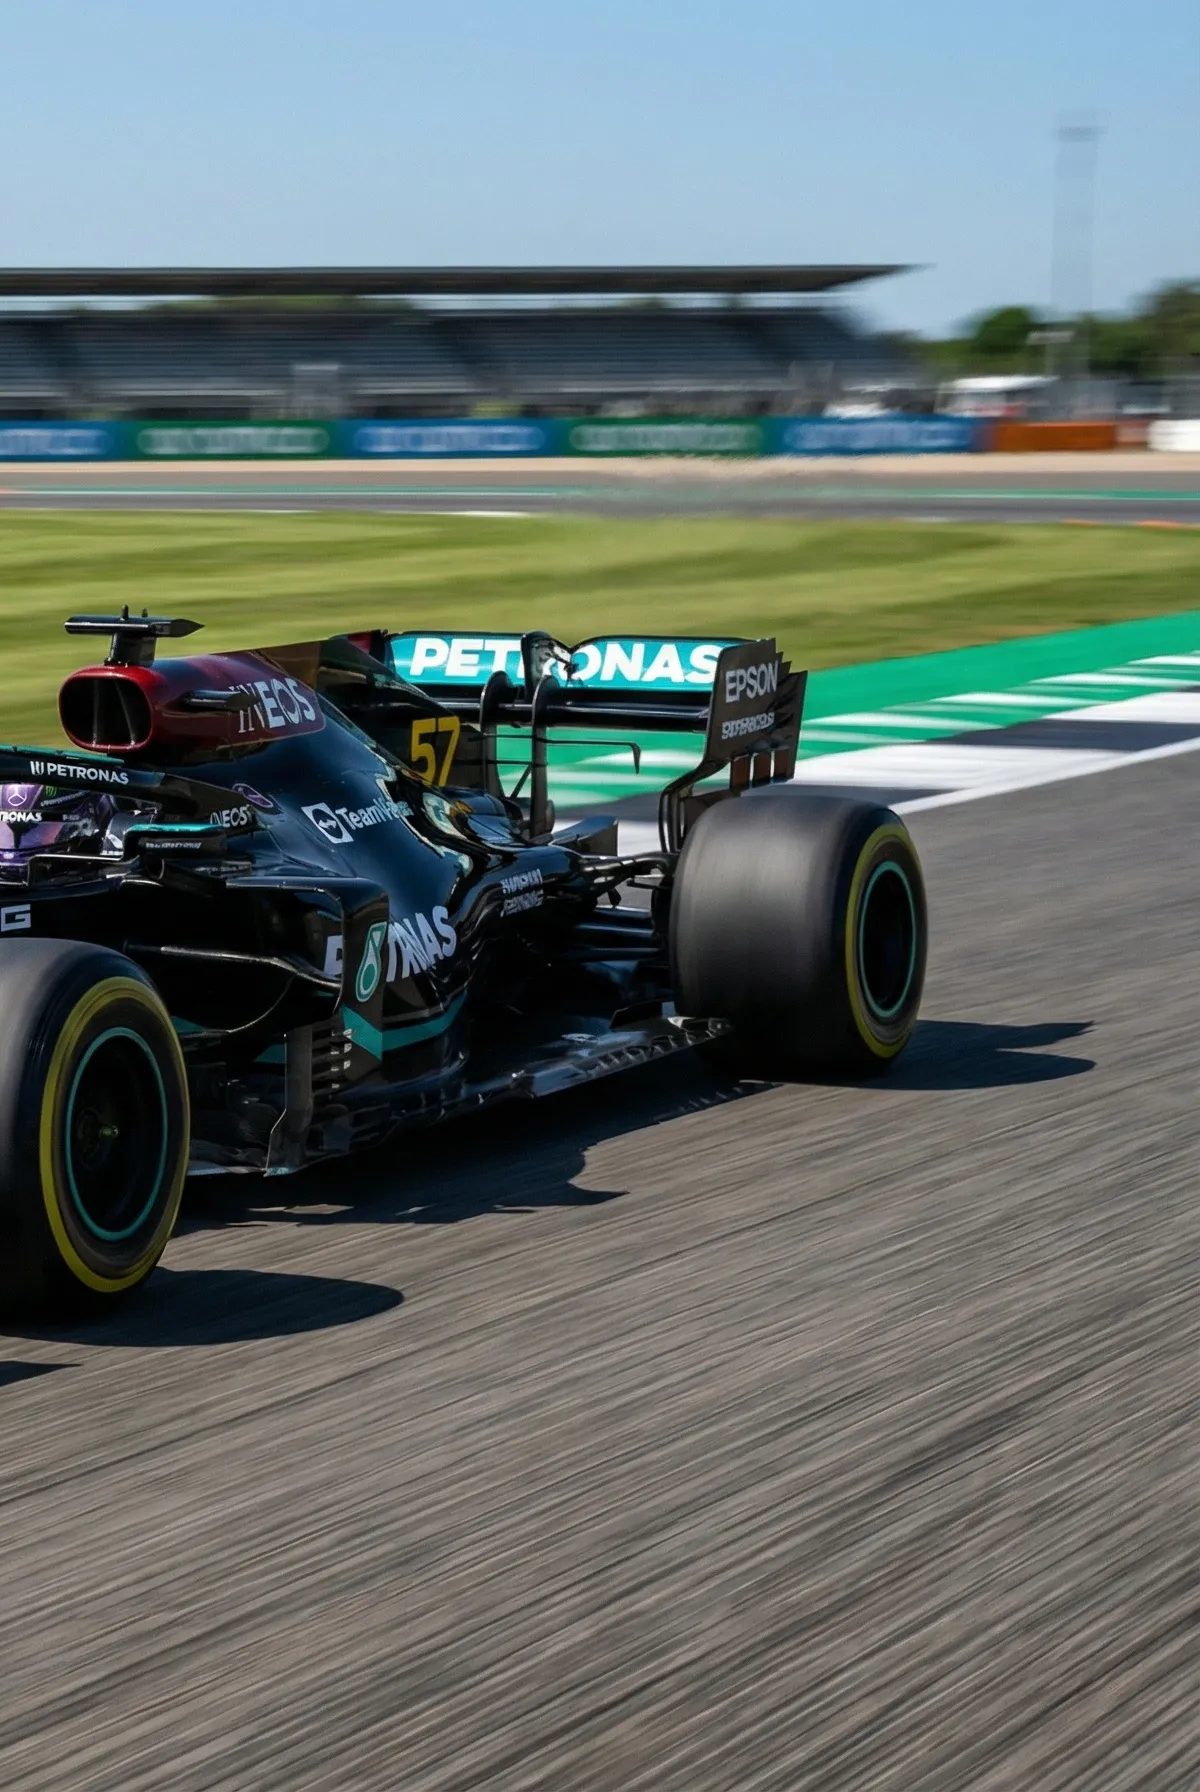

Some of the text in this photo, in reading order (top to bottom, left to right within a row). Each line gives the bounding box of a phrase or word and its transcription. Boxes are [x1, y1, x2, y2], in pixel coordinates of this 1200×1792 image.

[410, 637, 720, 683] PETONAS
[725, 660, 779, 703] EPSON
[411, 715, 460, 787] 57
[46, 762, 129, 785] PETRONAS
